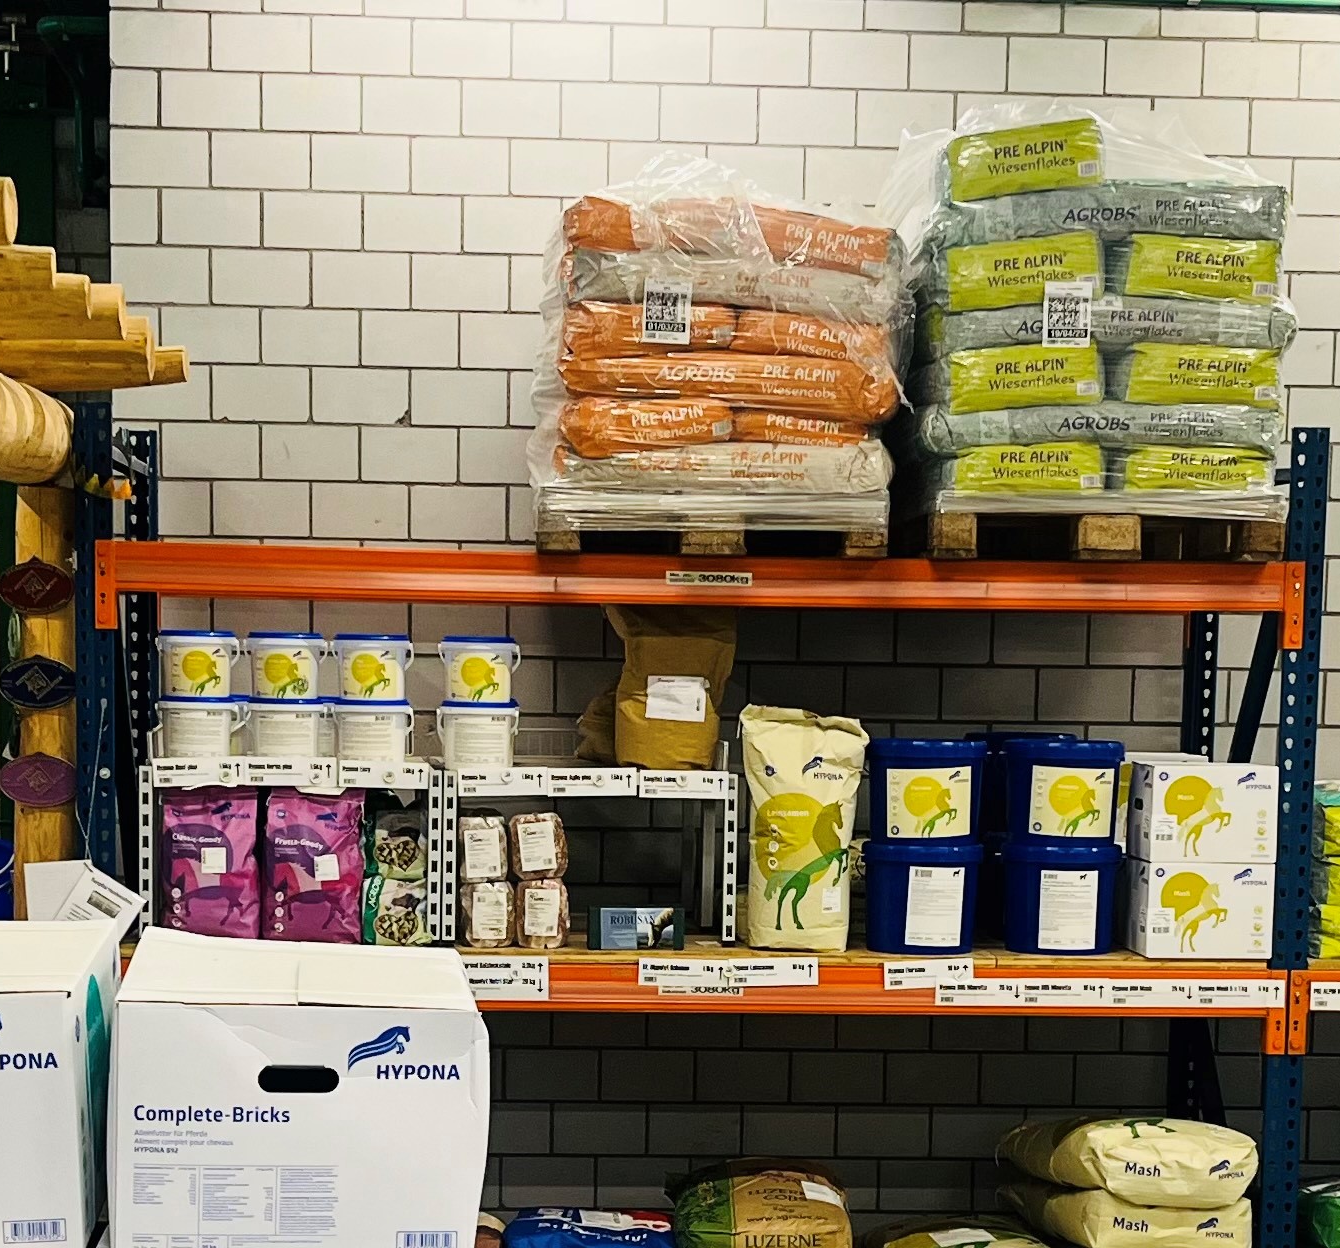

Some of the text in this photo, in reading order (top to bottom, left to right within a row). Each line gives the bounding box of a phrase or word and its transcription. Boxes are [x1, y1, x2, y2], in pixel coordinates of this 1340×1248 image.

[994, 144, 1020, 160] PRE
[987, 155, 1076, 176] Wiesenflakes
[994, 258, 1020, 271] PRE
[987, 269, 1075, 288] Wiesenflakes
[788, 321, 817, 336] PRE
[995, 361, 1022, 375] PRE
[988, 374, 1075, 391] Wiesenflakes
[993, 466, 1079, 480] Wiesenflakes
[376, 1064, 460, 1081] HYPONA
[134, 1105, 290, 1126] Complete-Bricks
[1124, 1162, 1160, 1178] Mash
[1113, 1216, 1149, 1233] Mash
[745, 1234, 821, 1248] LUZERNE
